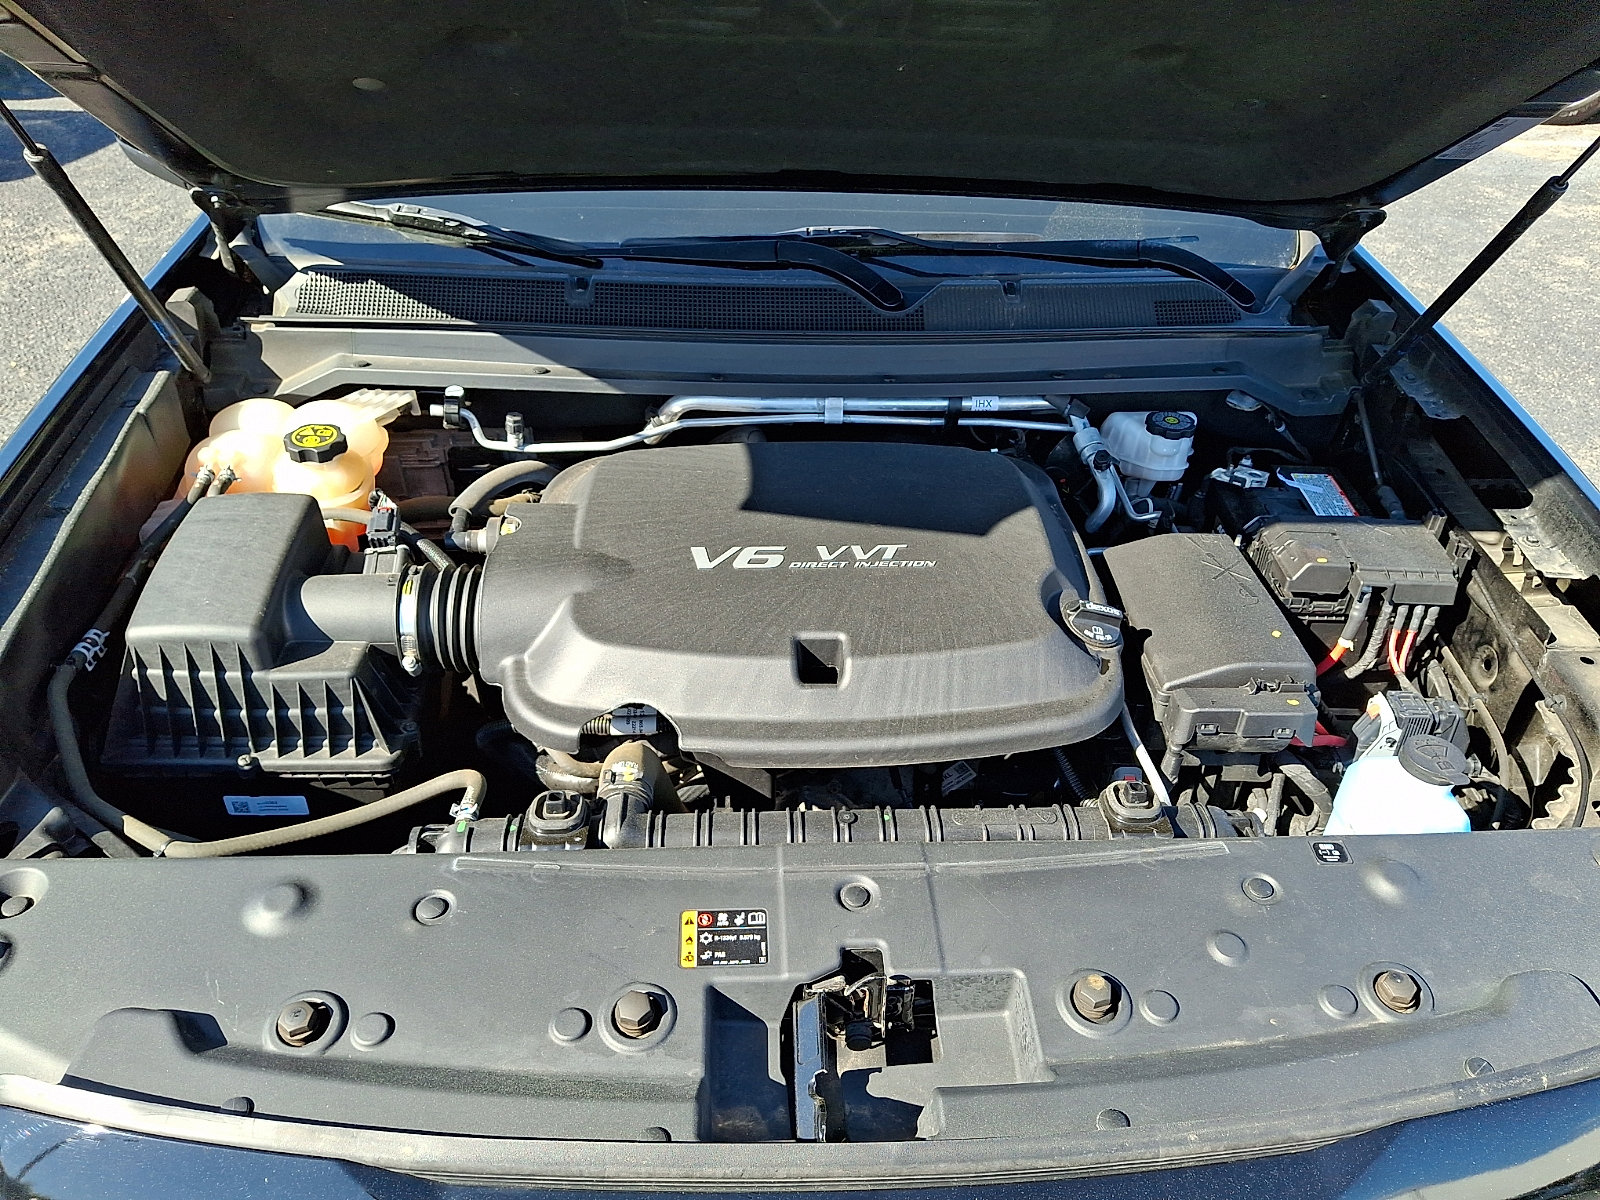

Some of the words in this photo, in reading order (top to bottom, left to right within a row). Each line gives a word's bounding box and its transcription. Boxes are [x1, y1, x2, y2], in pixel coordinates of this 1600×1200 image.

[975, 399, 993, 408] IHX
[690, 545, 787, 570] V6
[815, 543, 908, 561] VVT
[788, 560, 850, 569] DIRECT
[853, 559, 938, 569] INJECTION
[1085, 601, 1121, 616] dexos
